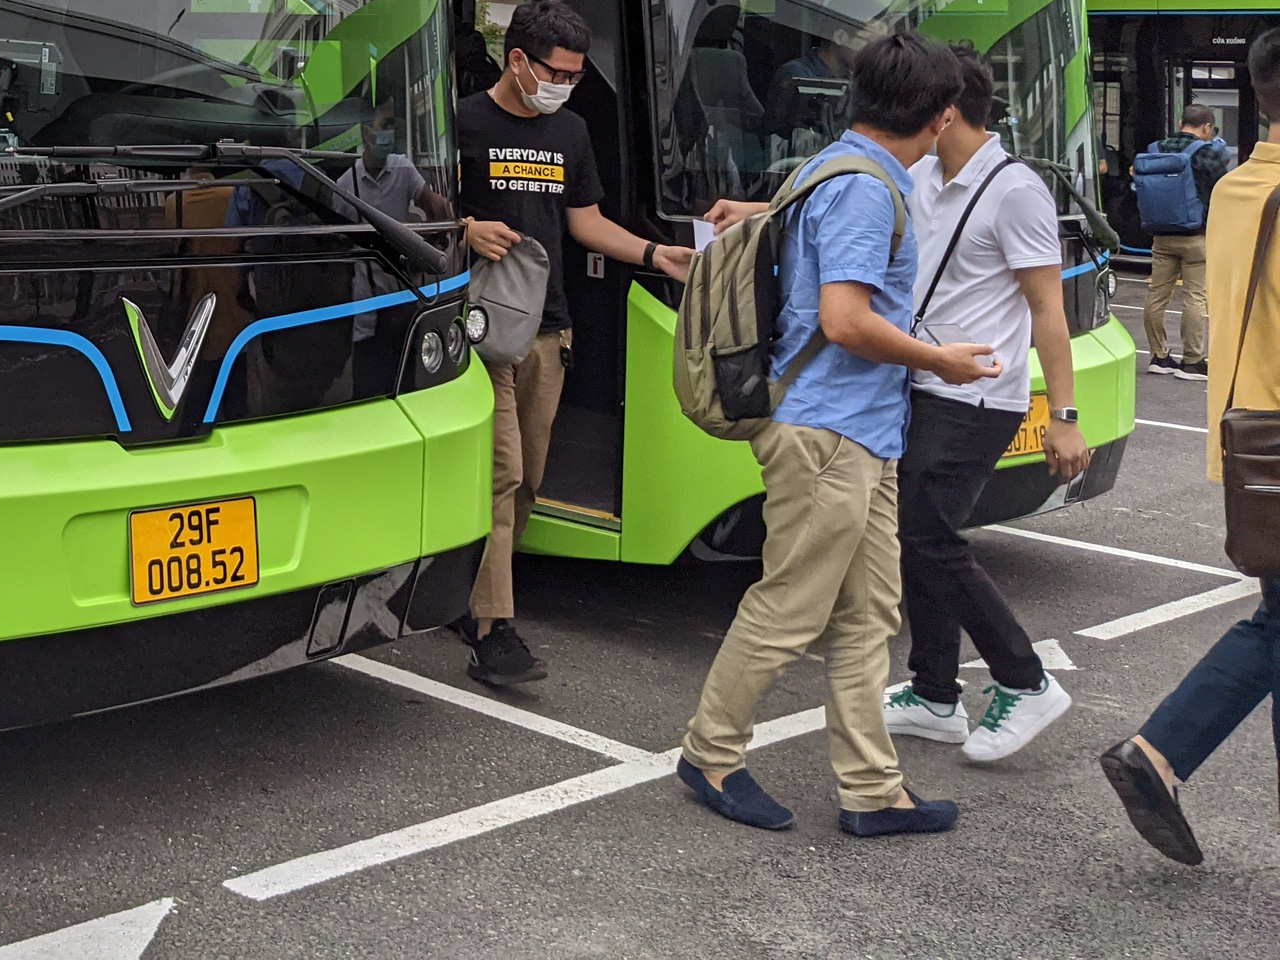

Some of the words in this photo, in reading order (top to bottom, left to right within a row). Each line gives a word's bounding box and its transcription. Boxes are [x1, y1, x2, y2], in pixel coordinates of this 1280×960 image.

[488, 148, 552, 163] EVERYDAY
[553, 152, 564, 165] IS
[502, 165, 511, 174] A
[513, 165, 556, 177] CHANCE
[489, 180, 507, 190] TO
[168, 506, 221, 549] 29F
[147, 545, 246, 596] 008.52
